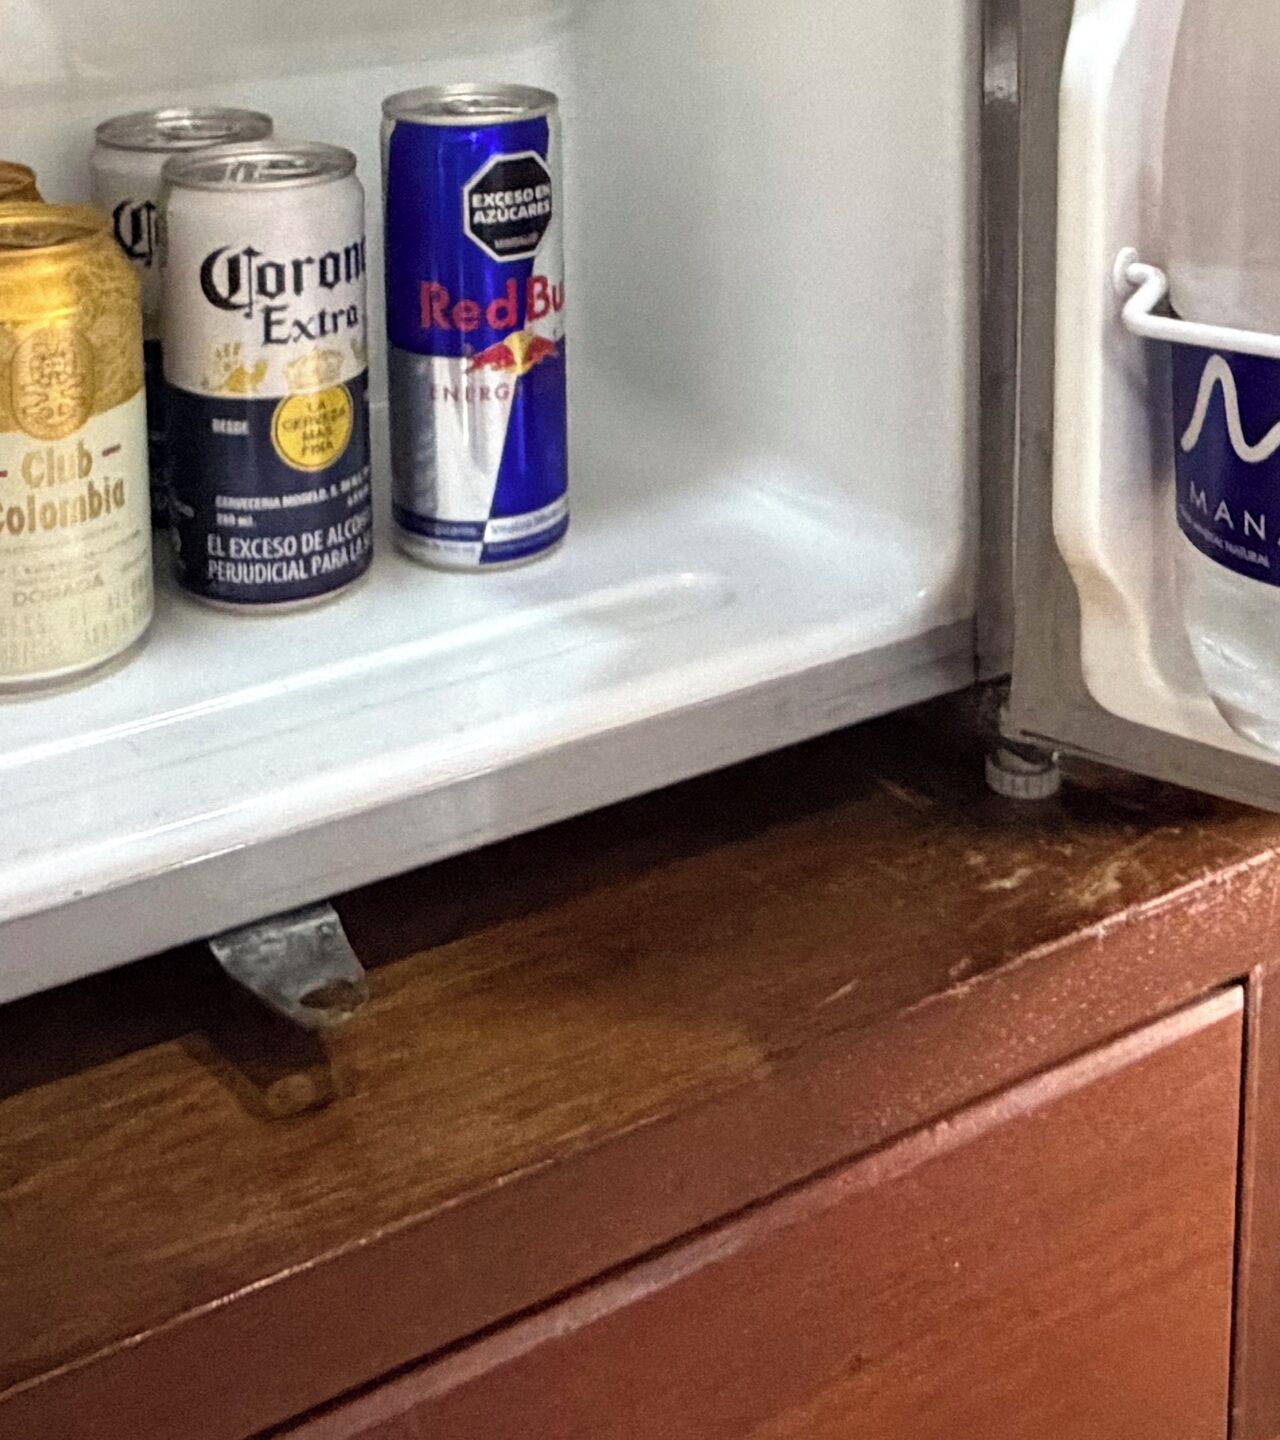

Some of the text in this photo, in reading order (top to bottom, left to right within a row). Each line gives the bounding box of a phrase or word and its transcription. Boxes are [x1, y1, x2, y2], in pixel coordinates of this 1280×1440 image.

[471, 189, 535, 208] EXCESO
[199, 236, 367, 319] Coron
[418, 274, 566, 331] Red Bu
[260, 304, 360, 347] Extra
[428, 382, 511, 402] ENERG
[20, 439, 94, 489] Club
[206, 533, 226, 557] EL
[229, 534, 298, 560] EXCESO
[301, 528, 326, 553] DE
[207, 558, 310, 585] PERJUDICIAL
[311, 546, 351, 577] PARA
